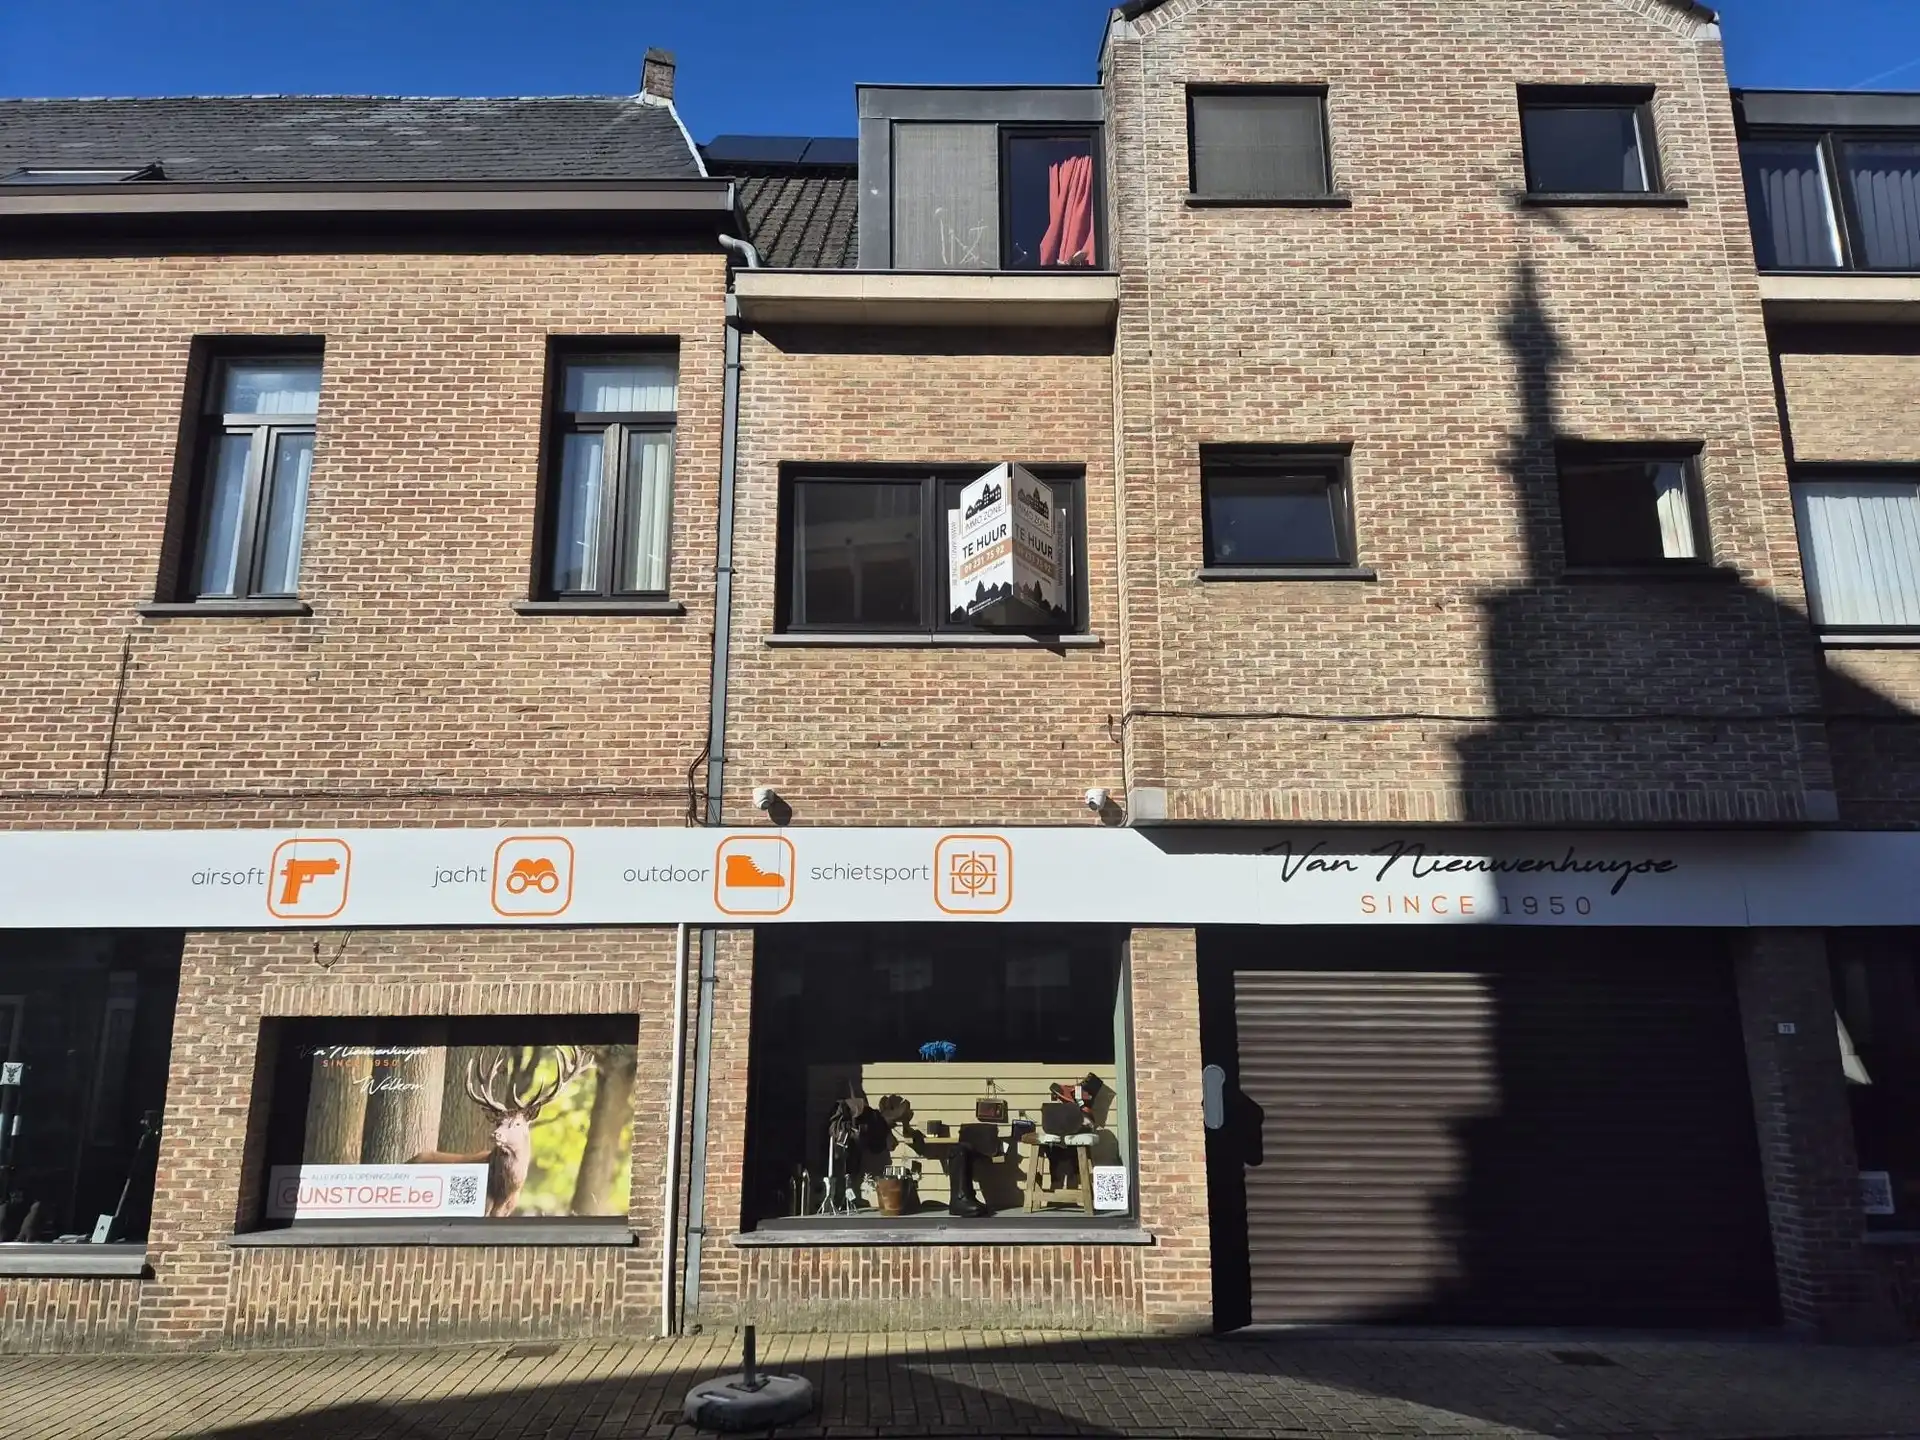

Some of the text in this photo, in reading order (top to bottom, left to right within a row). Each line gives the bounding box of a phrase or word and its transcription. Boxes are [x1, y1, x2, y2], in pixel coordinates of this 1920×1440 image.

[984, 503, 1004, 521] ZONE
[962, 524, 1007, 558] TE HUUR
[1014, 522, 1053, 559] TE HUUR
[191, 866, 264, 886] airsoft
[432, 865, 487, 889] jacht
[623, 864, 710, 883] outdoor
[811, 864, 929, 885] schietsport
[1264, 840, 1678, 895] Van Nieuwenhuyse
[1361, 895, 1593, 915] SINCE 1950
[283, 1185, 434, 1204] GUNSTORE.be
